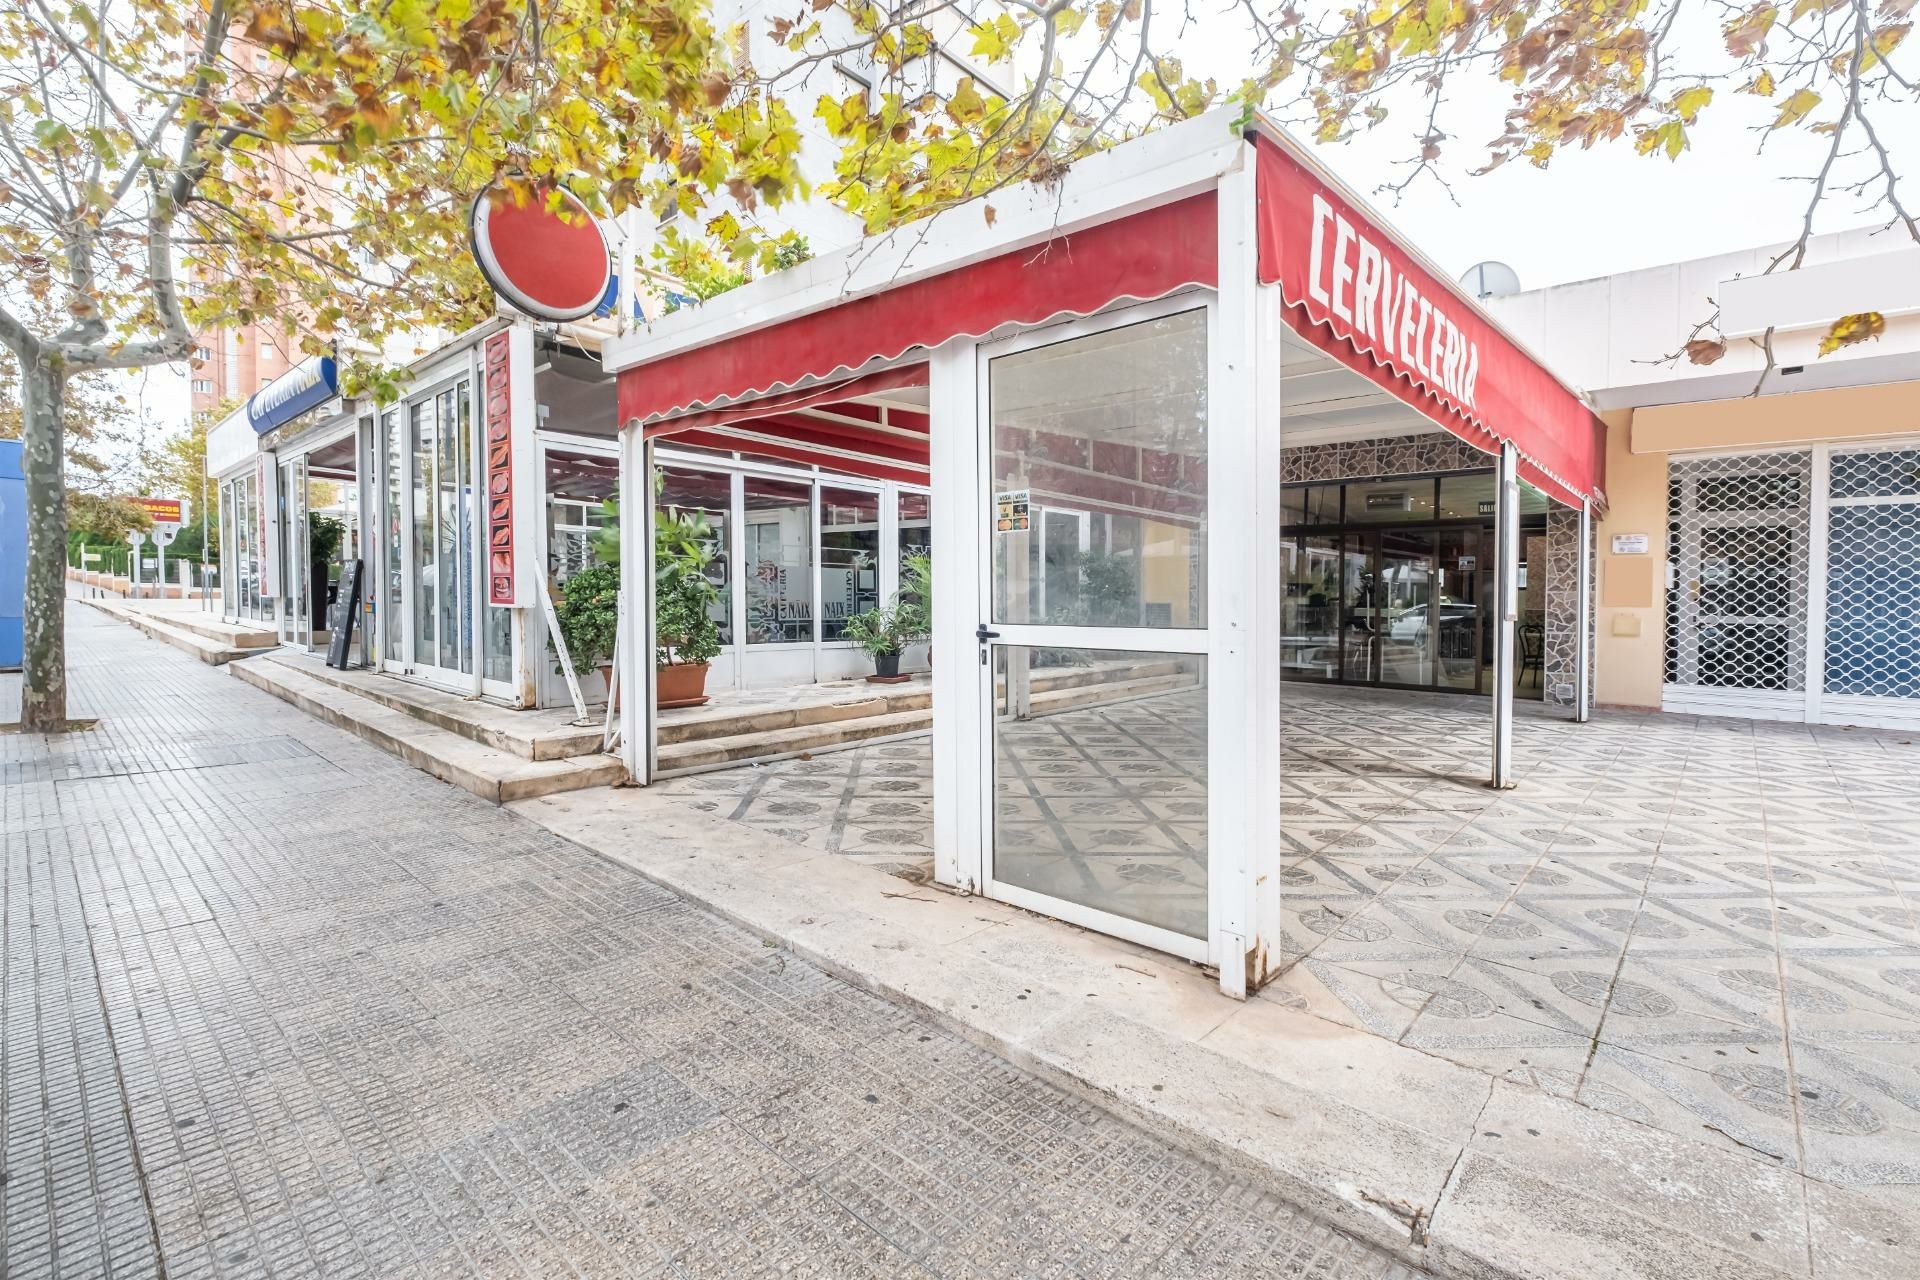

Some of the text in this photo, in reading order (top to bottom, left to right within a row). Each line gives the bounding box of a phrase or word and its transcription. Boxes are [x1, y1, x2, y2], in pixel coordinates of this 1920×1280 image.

[1309, 194, 1479, 410] CERVECERIA
[139, 504, 180, 512] BACOS
[1480, 504, 1496, 512] SALI
[779, 568, 787, 619] CAFETERIA
[824, 601, 846, 619] NAIX
